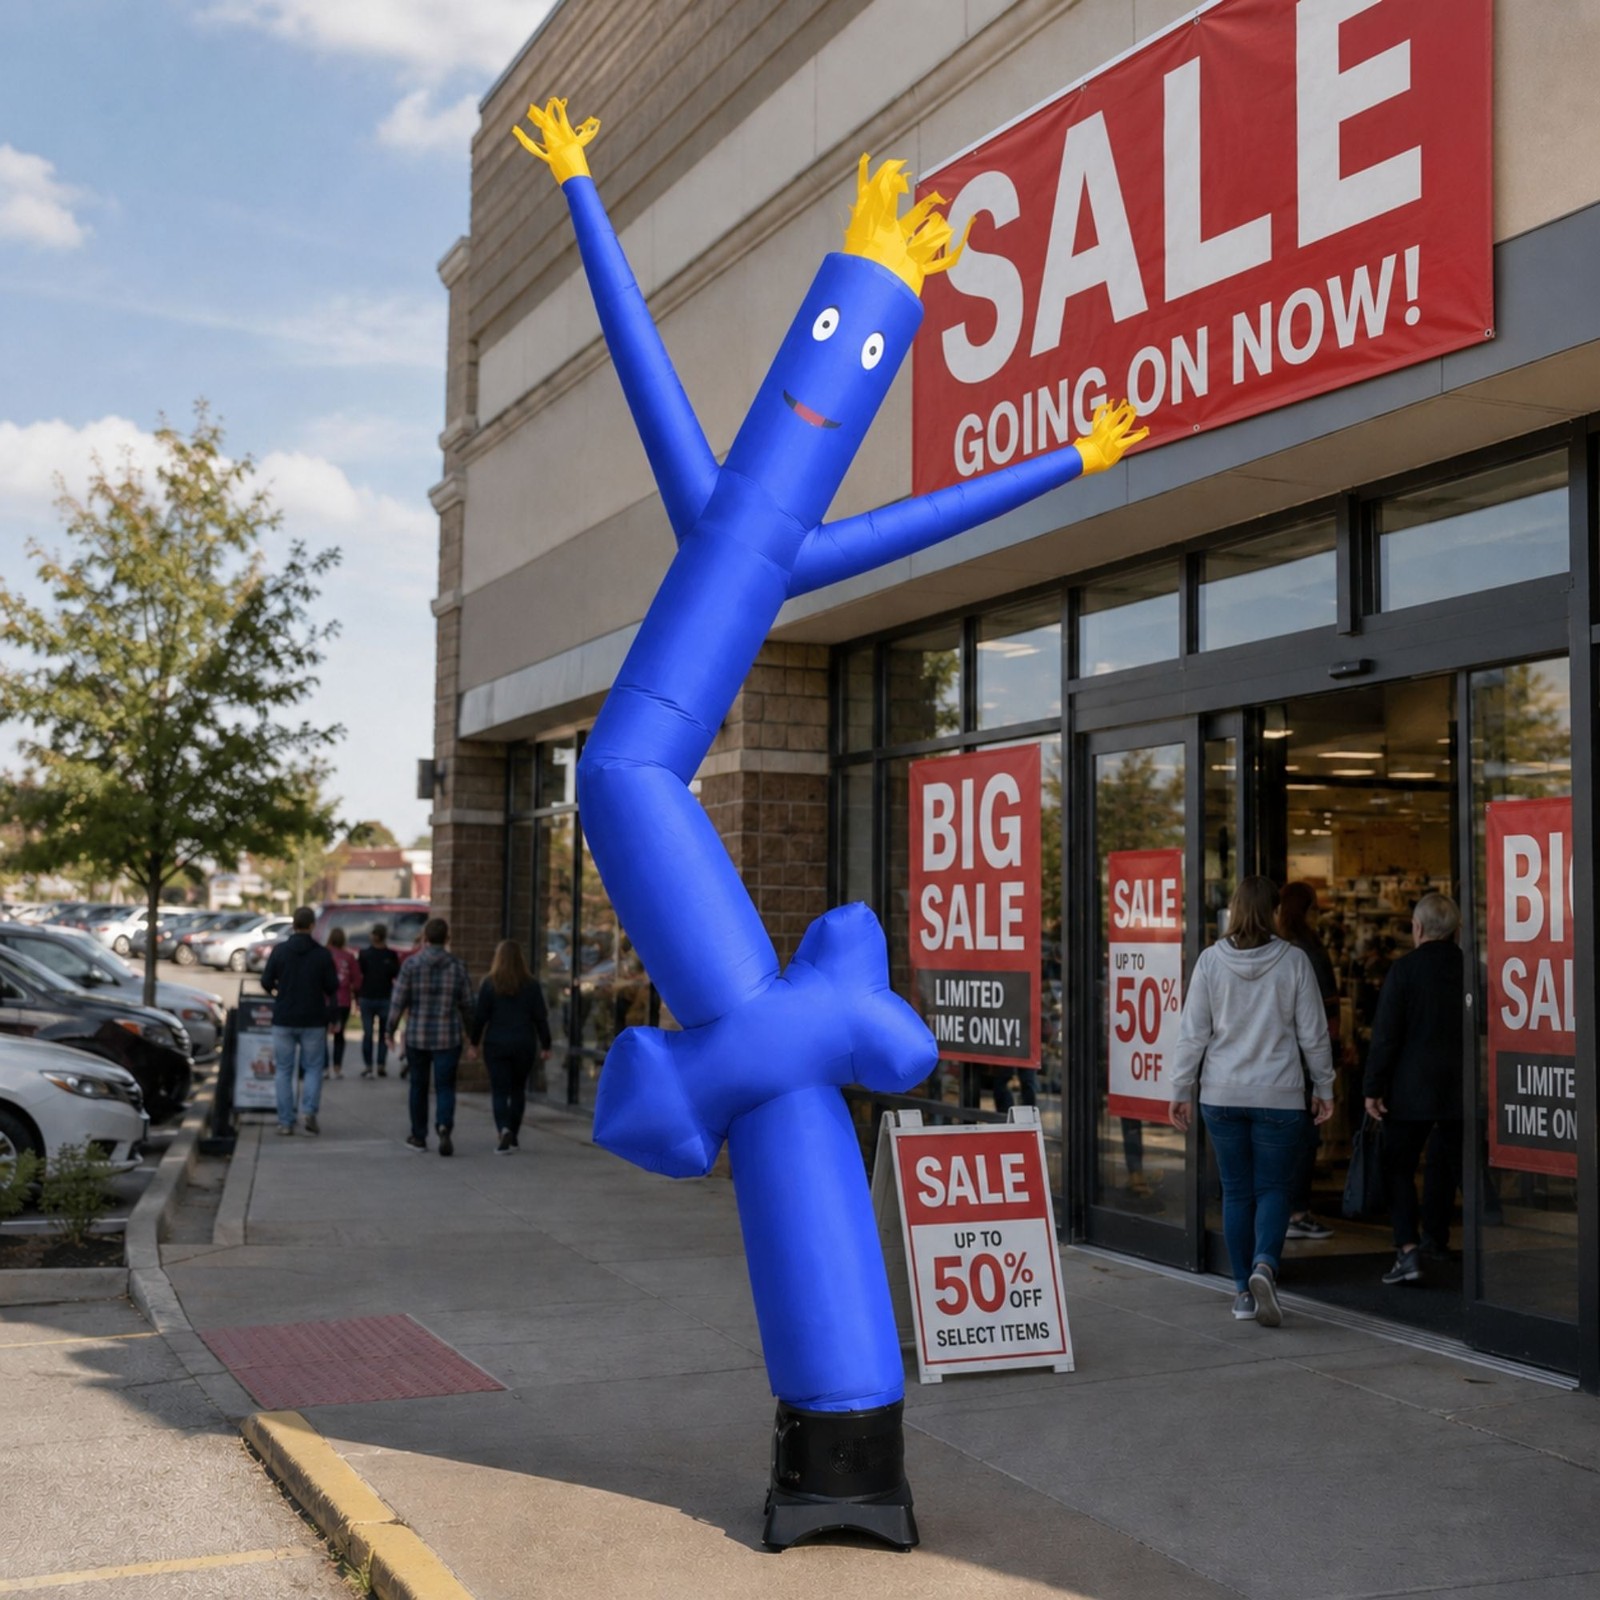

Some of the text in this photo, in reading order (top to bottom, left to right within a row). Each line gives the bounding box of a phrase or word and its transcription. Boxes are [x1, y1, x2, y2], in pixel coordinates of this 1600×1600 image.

[942, 0, 1422, 384] SALE
[954, 244, 1420, 477] GOING ON NOW!
[923, 772, 1022, 873] BIG
[1114, 878, 1176, 929] SALE
[1503, 832, 1574, 943] BI
[920, 881, 1025, 951] SALE
[1115, 953, 1145, 970] UP TO
[936, 979, 1005, 1009] LIMITED
[1114, 976, 1178, 1045] 50%
[969, 1016, 1020, 1048] ONLY!
[1131, 1051, 1163, 1082] OFF
[1504, 1104, 1548, 1137] TIME
[915, 1153, 1030, 1208] SALE
[954, 1230, 1002, 1248] UP TO
[934, 1252, 1042, 1316] 50% OFF
[937, 1322, 1050, 1347] SELECT ITEMS
